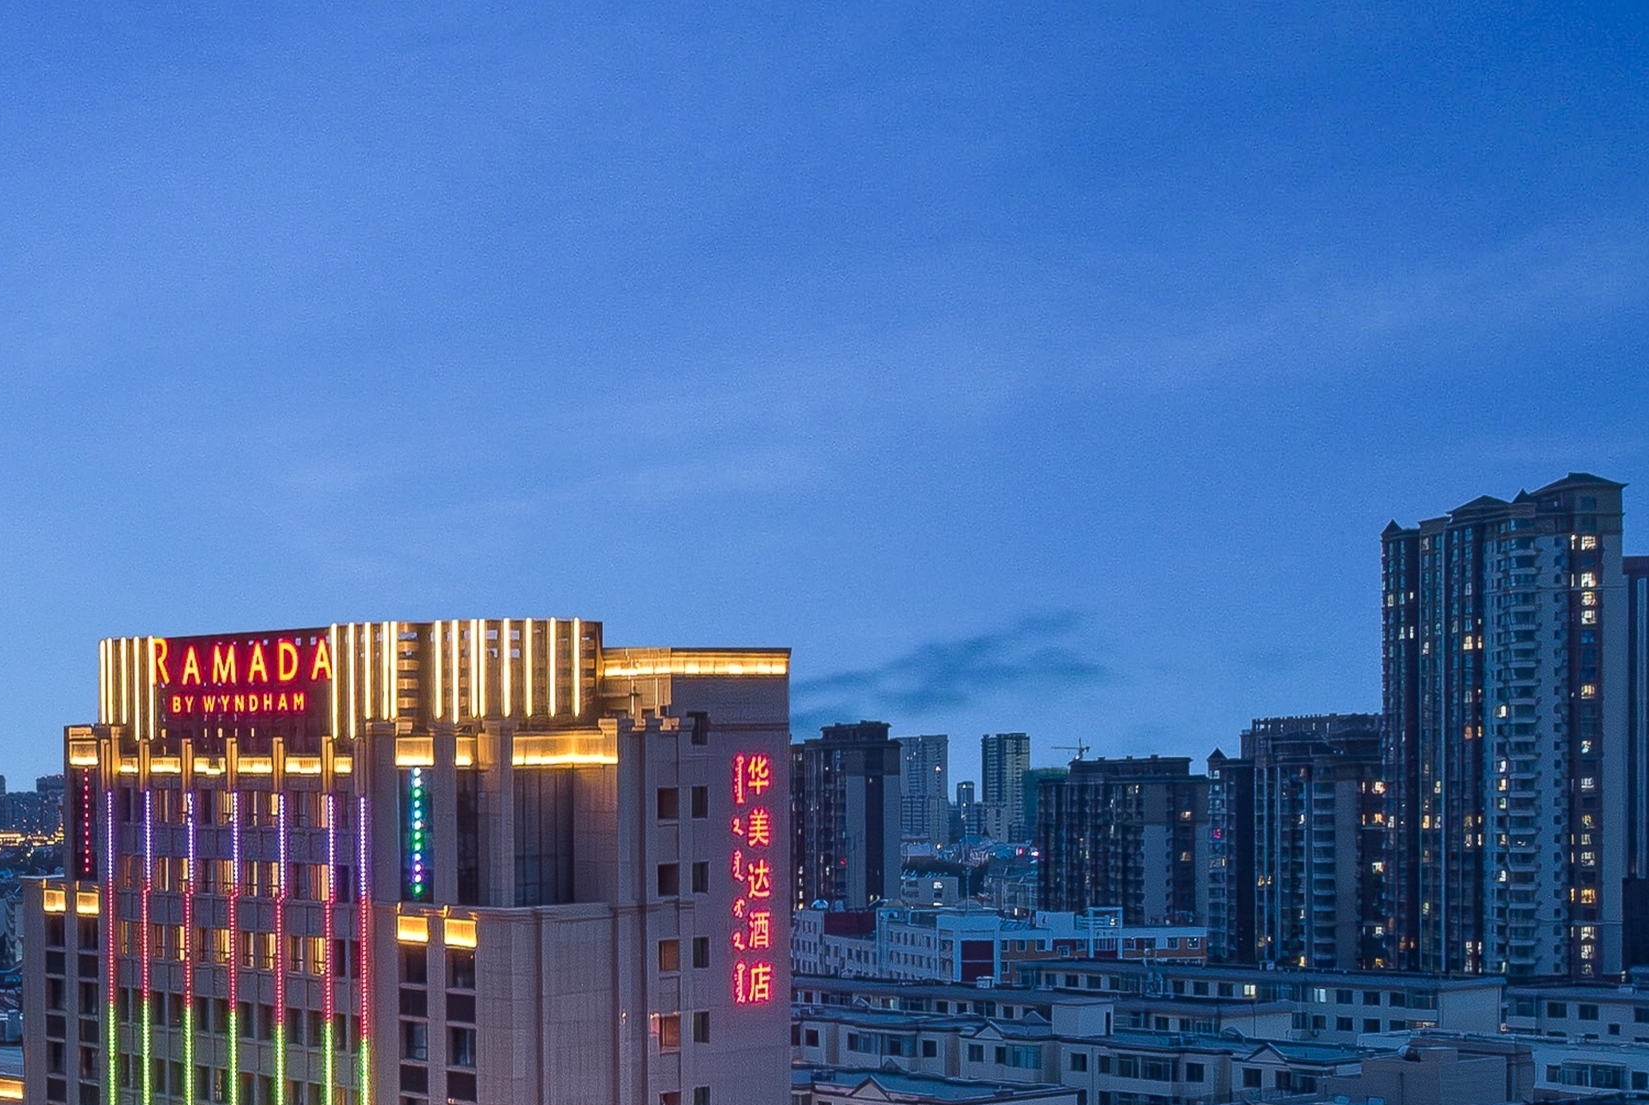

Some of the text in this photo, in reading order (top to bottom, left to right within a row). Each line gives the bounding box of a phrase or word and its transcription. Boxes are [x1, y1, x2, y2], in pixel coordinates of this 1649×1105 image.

[152, 637, 333, 685] RAMADA
[172, 692, 305, 713] BY WYNDHAM
[747, 755, 771, 1002] 华美达酒店
